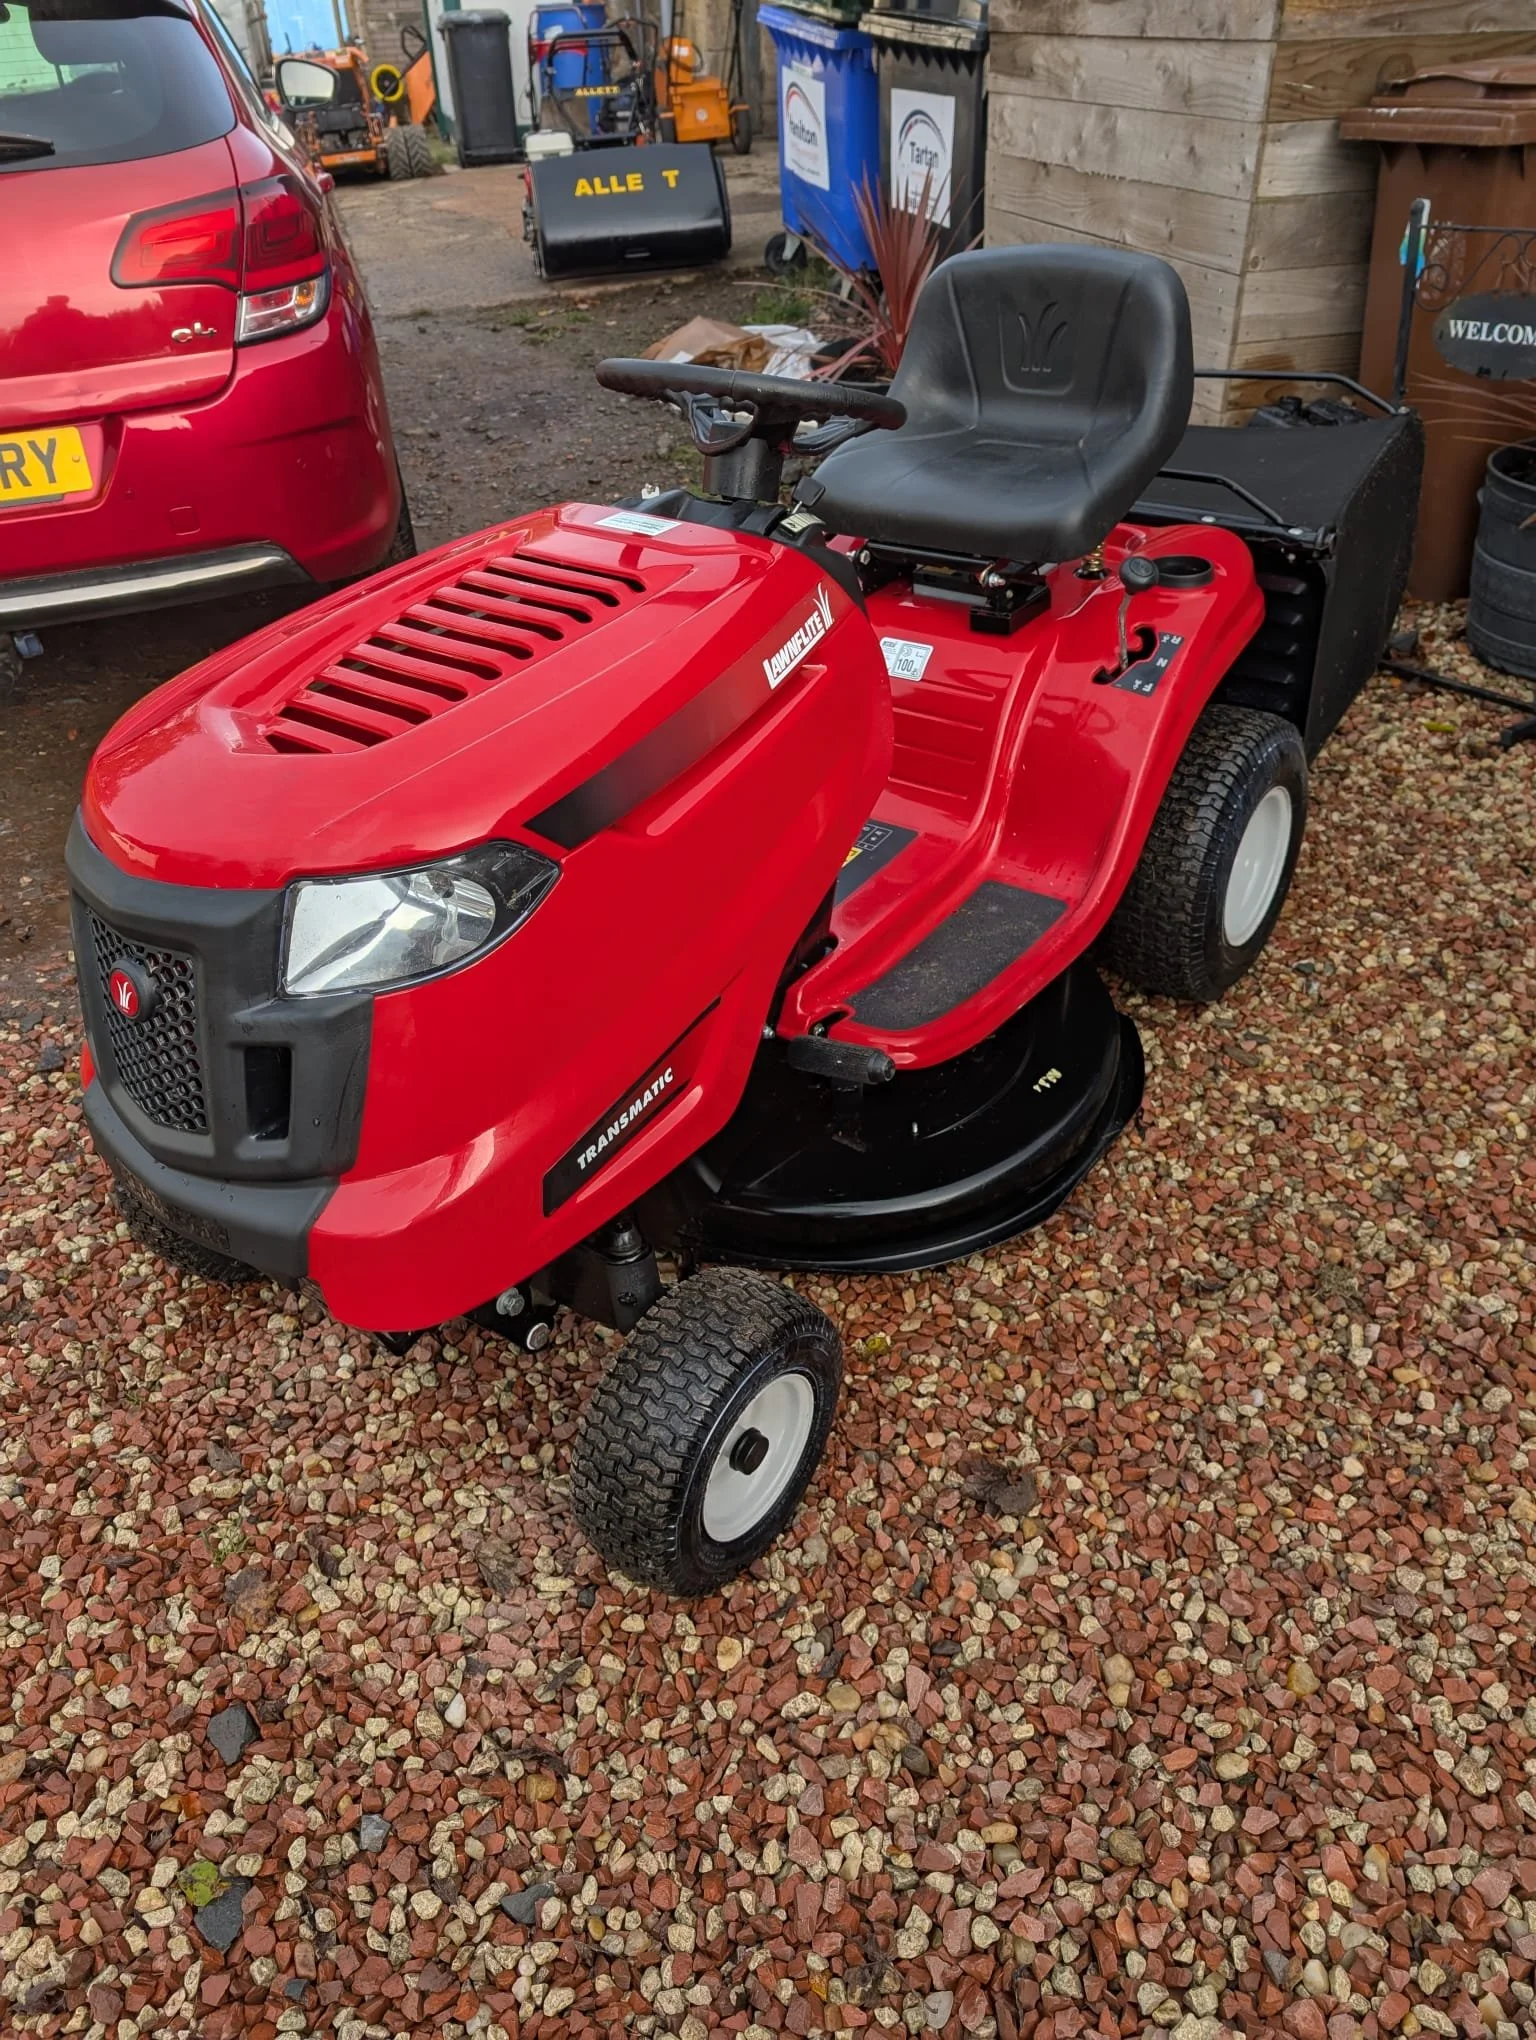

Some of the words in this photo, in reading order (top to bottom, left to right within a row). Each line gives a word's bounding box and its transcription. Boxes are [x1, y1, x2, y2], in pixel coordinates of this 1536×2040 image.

[575, 86, 620, 96] ALLETT
[0, 438, 57, 489] RY
[763, 610, 826, 690] LAWNFLITE
[897, 658, 914, 672] 100
[1156, 656, 1168, 668] N
[577, 1067, 674, 1171] TRANSMATIC
